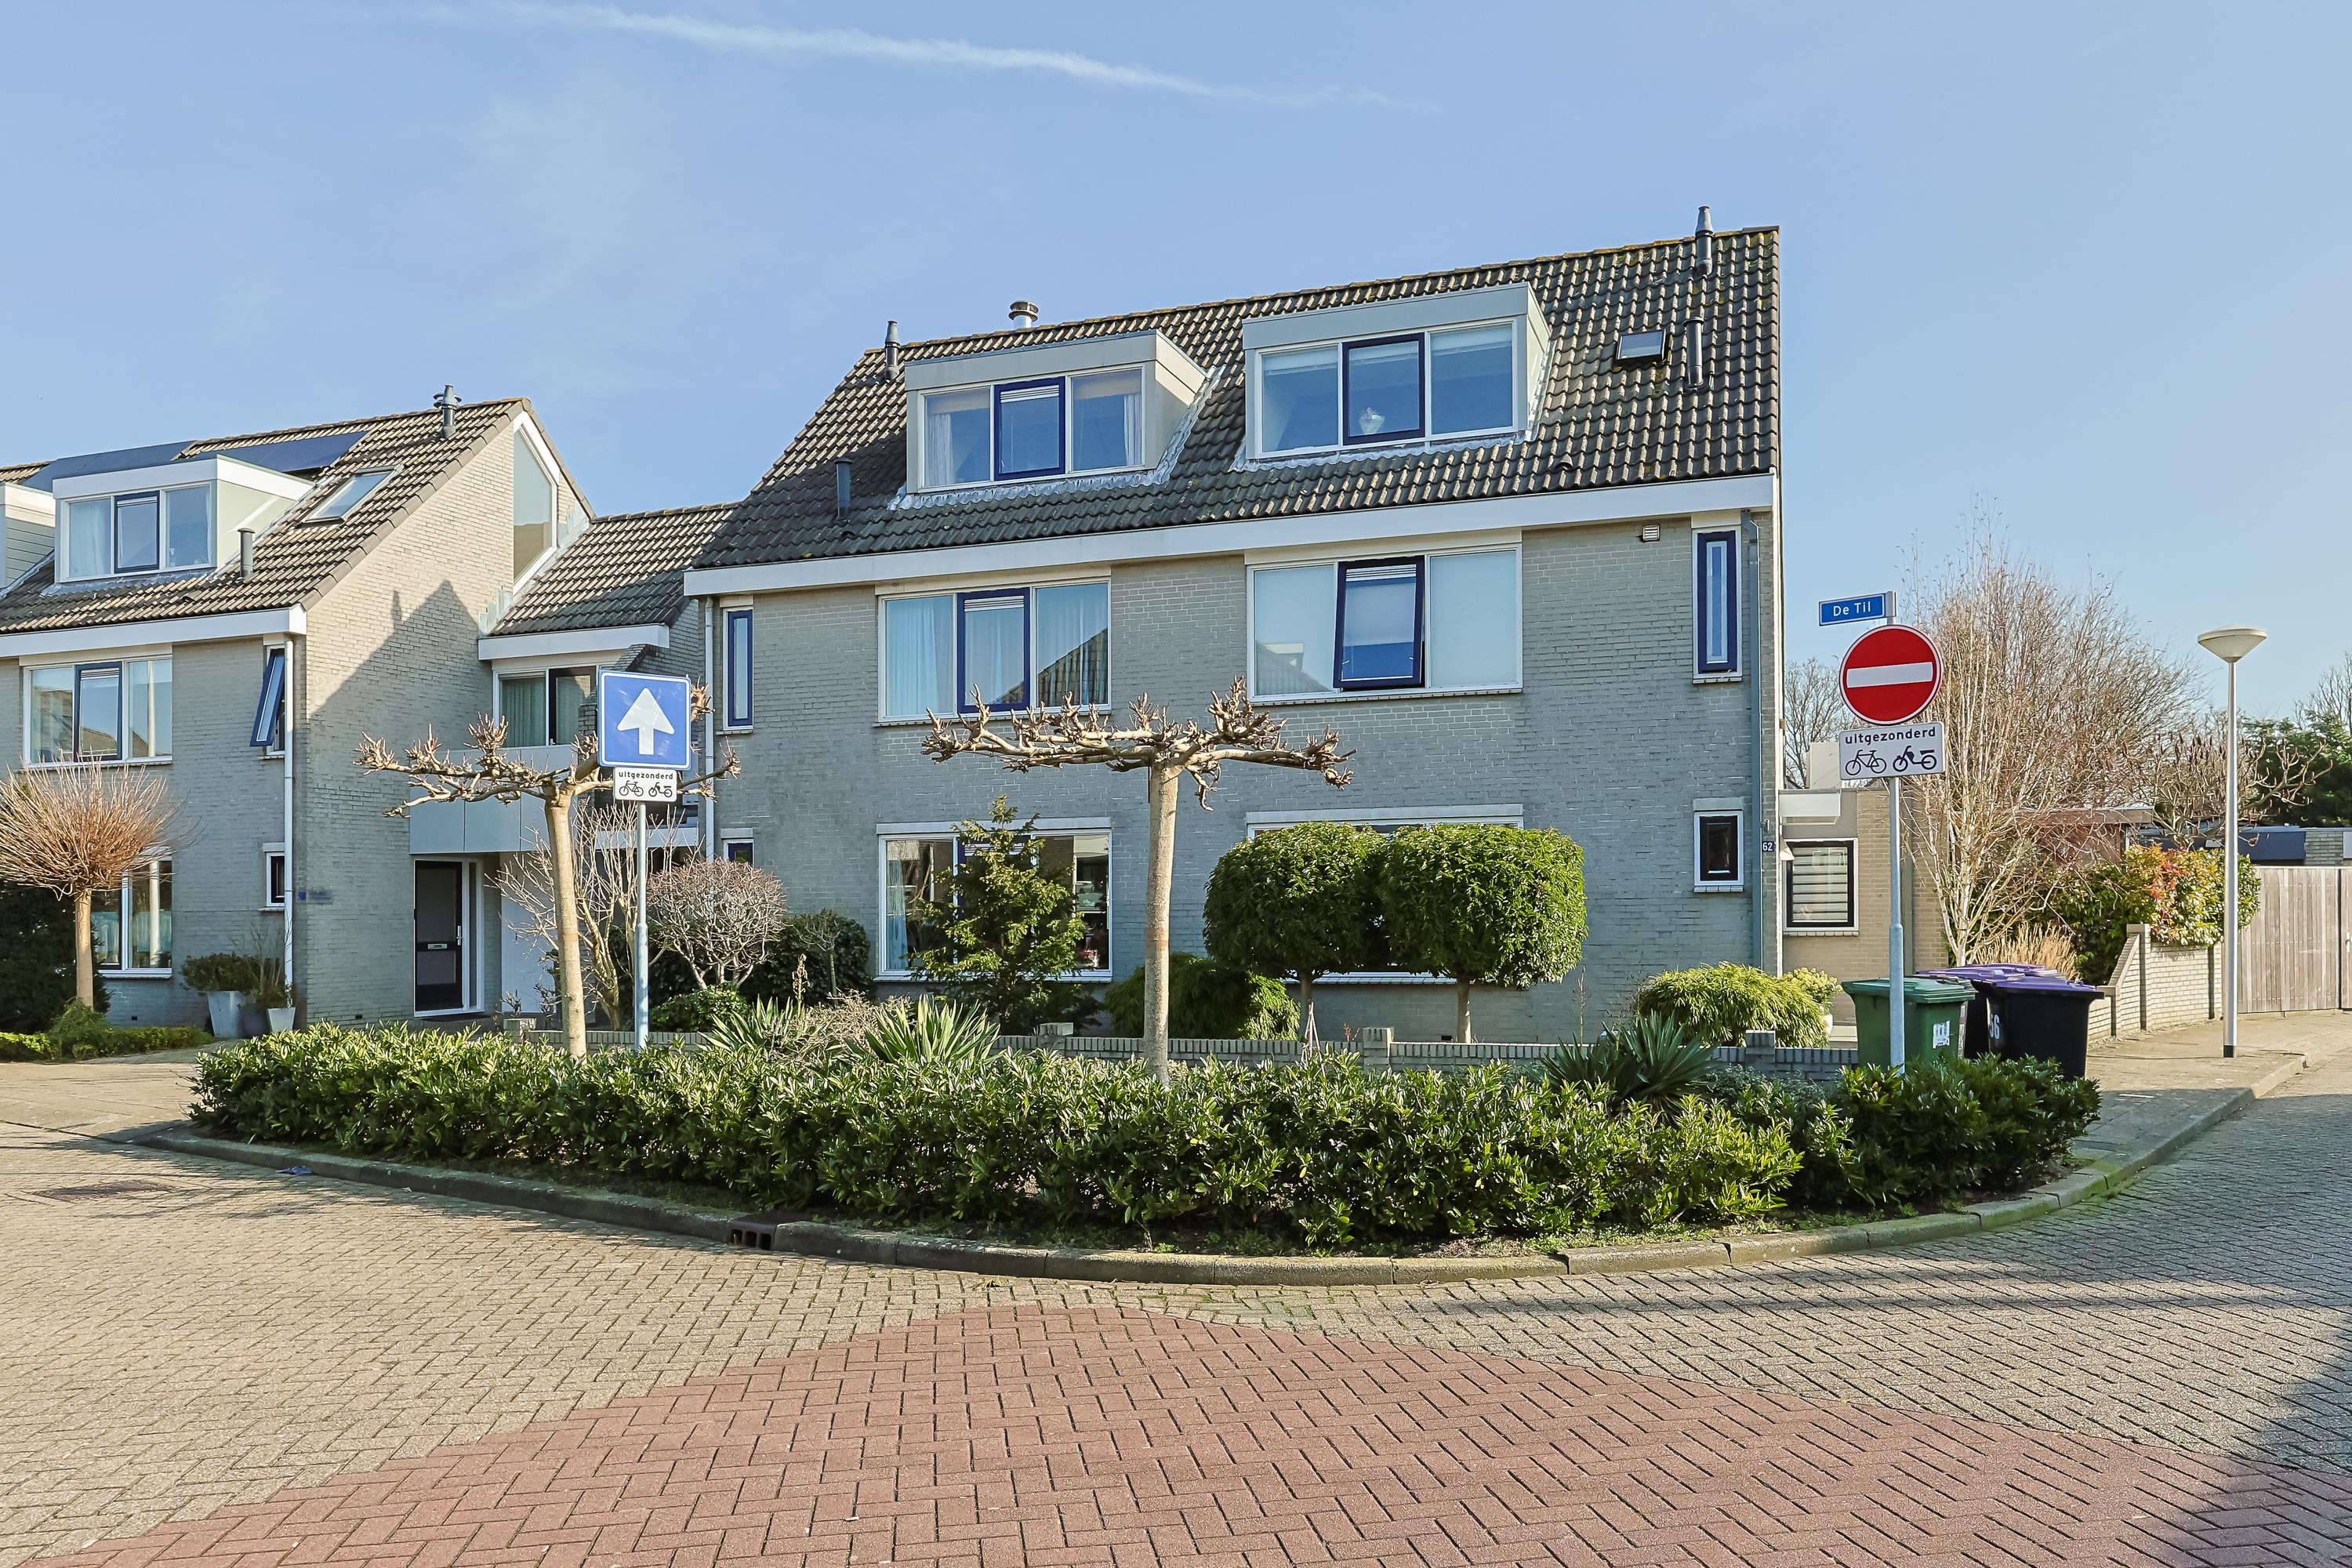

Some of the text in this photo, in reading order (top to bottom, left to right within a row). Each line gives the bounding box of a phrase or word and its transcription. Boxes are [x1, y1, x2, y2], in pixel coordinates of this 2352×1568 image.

[1833, 601, 1871, 617] De Til
[1845, 726, 1936, 746] uitgezonderd
[619, 771, 673, 780] uitgezonderd
[1762, 842, 1773, 851] 62
